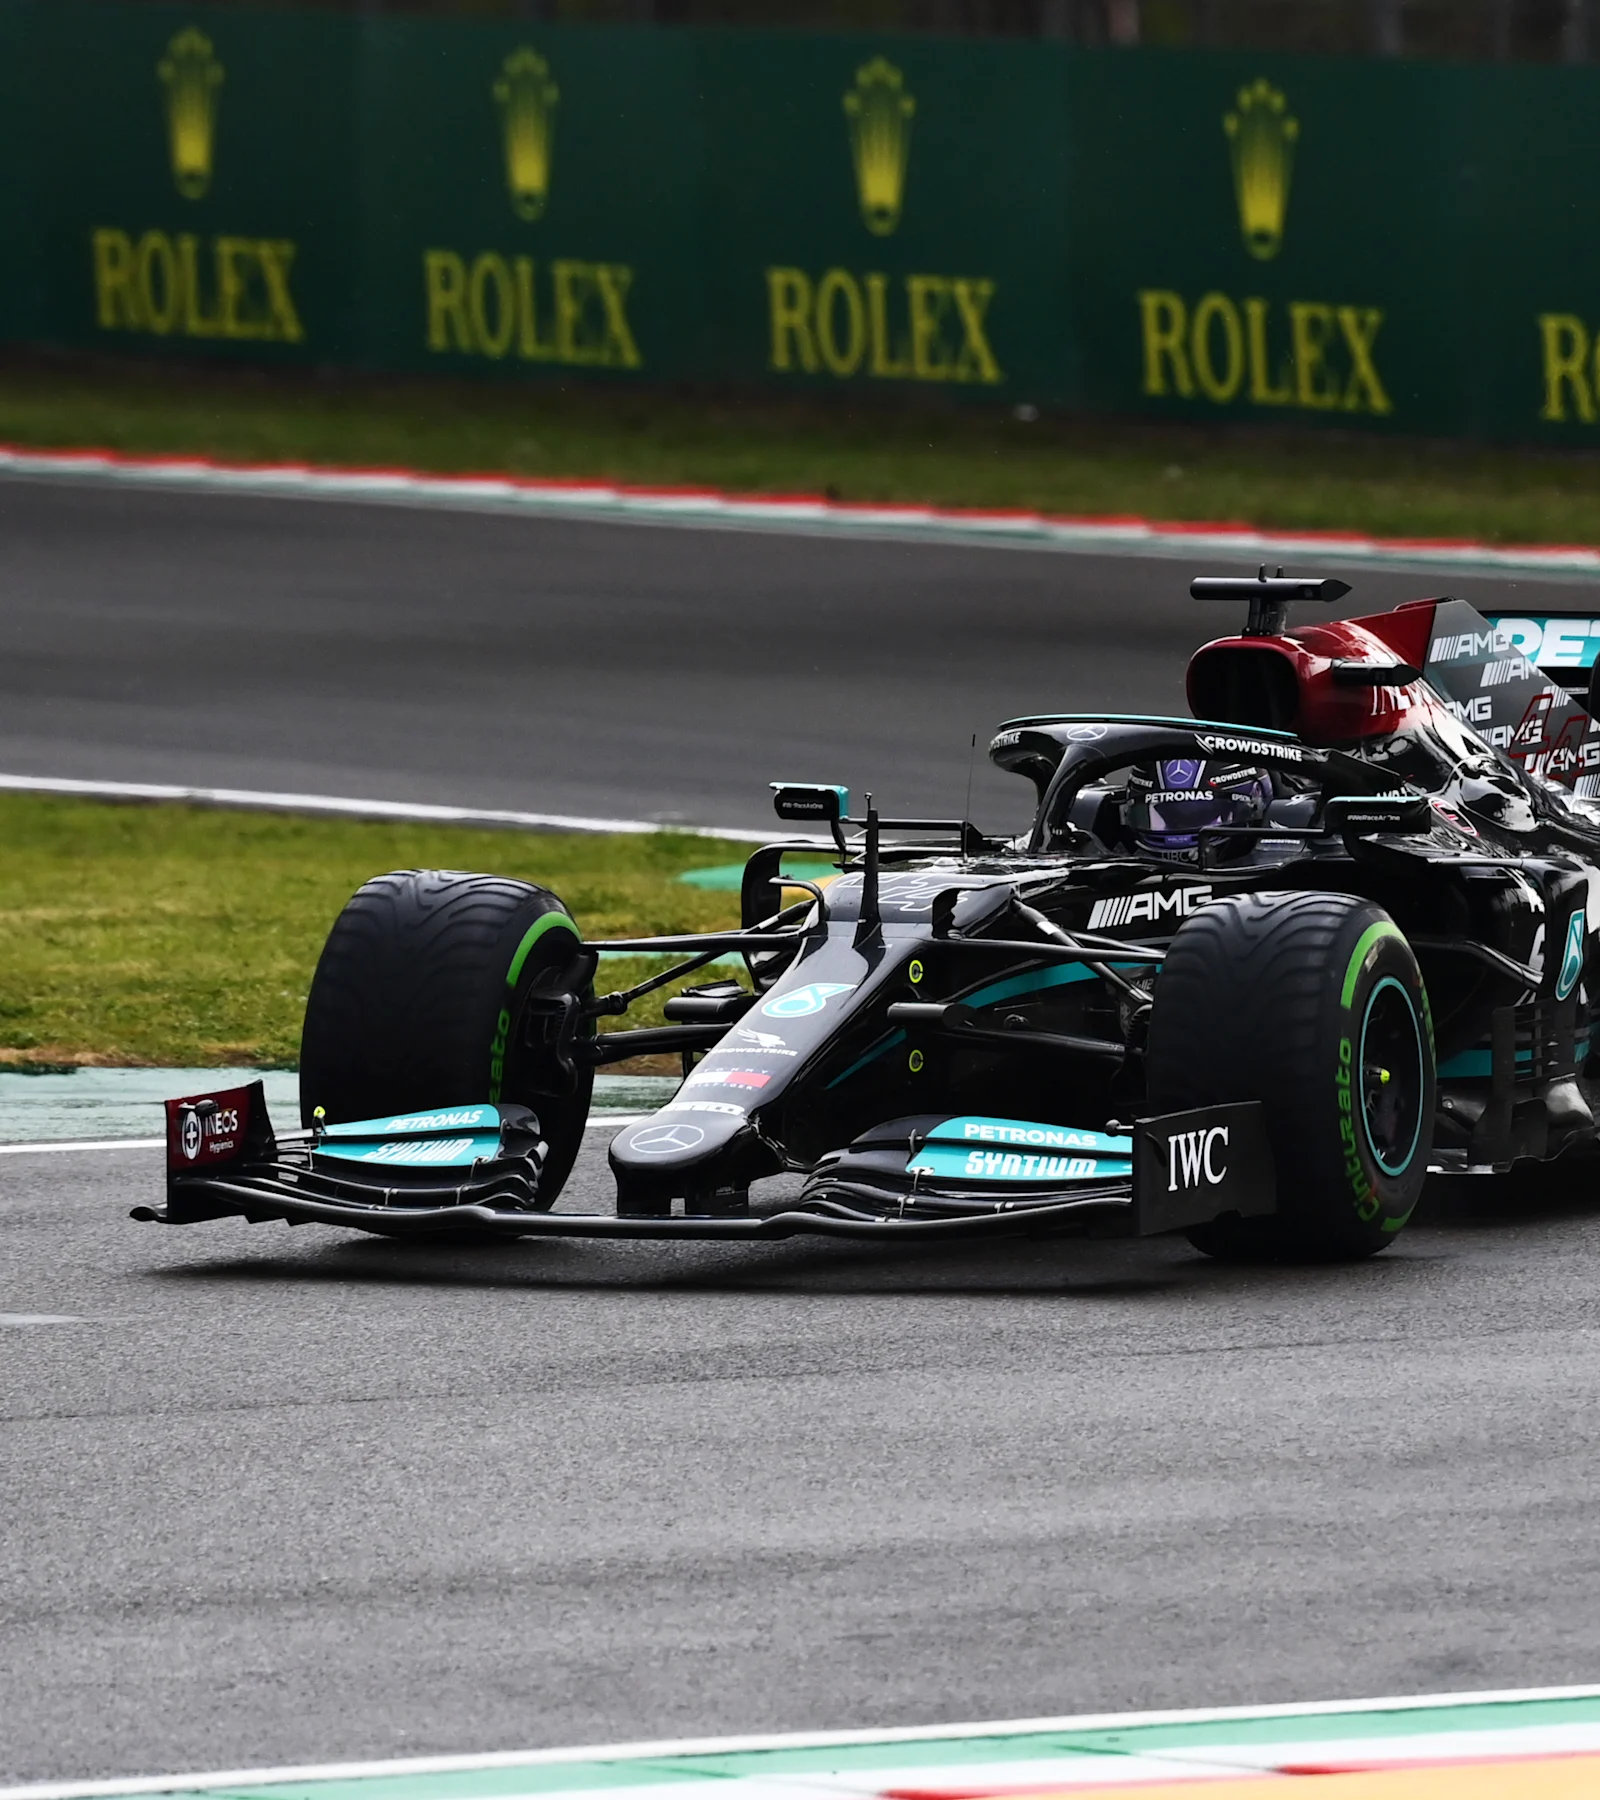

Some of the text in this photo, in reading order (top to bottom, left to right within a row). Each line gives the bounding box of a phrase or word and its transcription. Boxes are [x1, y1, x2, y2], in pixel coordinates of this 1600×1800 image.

[92, 228, 305, 344] ROLEX
[424, 249, 642, 367] ROLEX
[767, 266, 1003, 385] ROLEX
[1137, 290, 1391, 415] ROLEX
[1455, 629, 1511, 658] AMG
[1204, 735, 1302, 762] CROWDSTRIKE
[1210, 767, 1258, 786] CROWDSTRIKE
[1145, 790, 1214, 804] PETRONAS
[1127, 885, 1213, 924] AMG
[205, 1109, 238, 1137] INEOS
[384, 1109, 484, 1131] PETRONAS
[209, 1138, 234, 1154] Hygienics
[964, 1123, 1098, 1147] PETRONAS
[965, 1151, 1098, 1178] SYNTIUM
[1168, 1126, 1230, 1192] IWC
